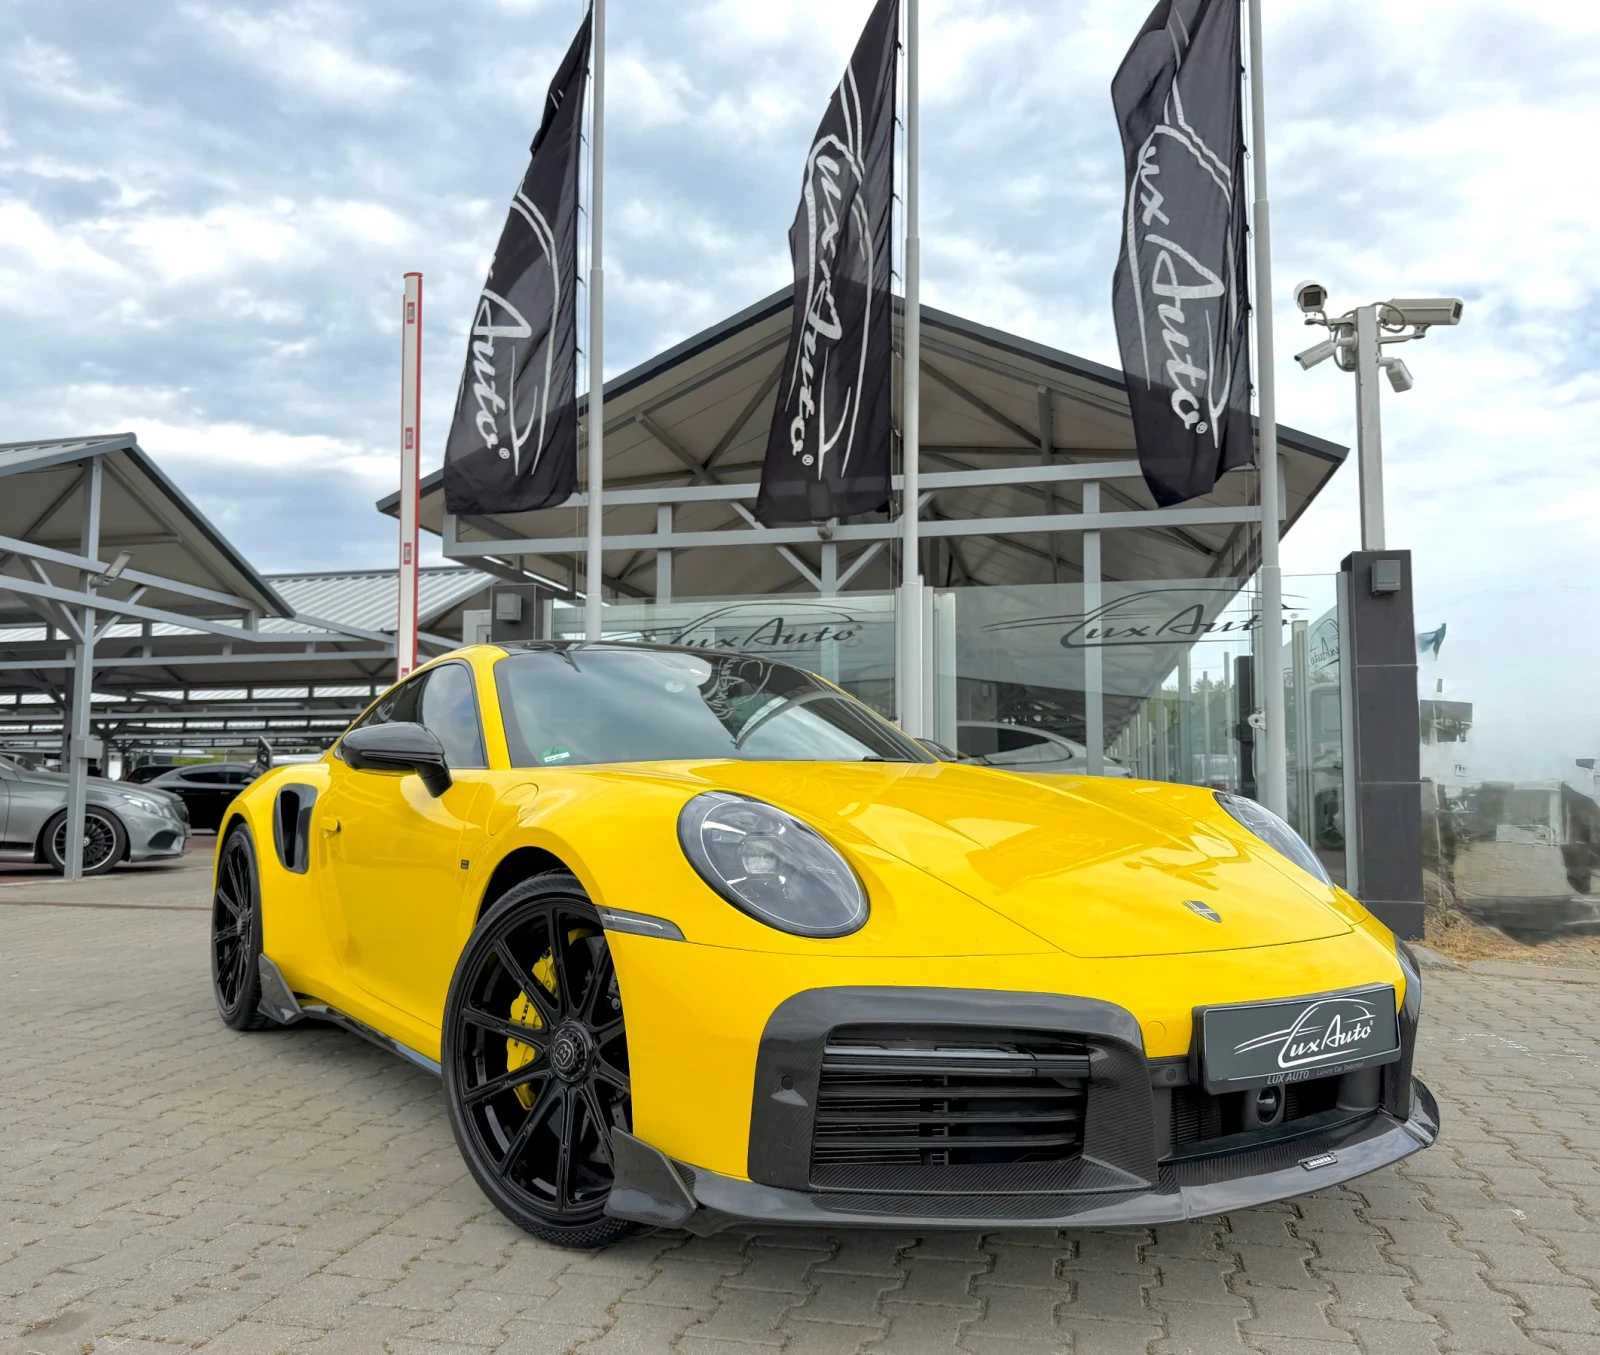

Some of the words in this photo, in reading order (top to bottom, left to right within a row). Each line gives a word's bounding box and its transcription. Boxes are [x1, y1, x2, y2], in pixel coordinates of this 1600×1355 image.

[472, 287, 533, 450] Auto
[1155, 603, 1289, 637] Aut
[1320, 1013, 1372, 1051] Auto
[1266, 1073, 1284, 1085] LUX
[1285, 1070, 1310, 1082] AUTO
